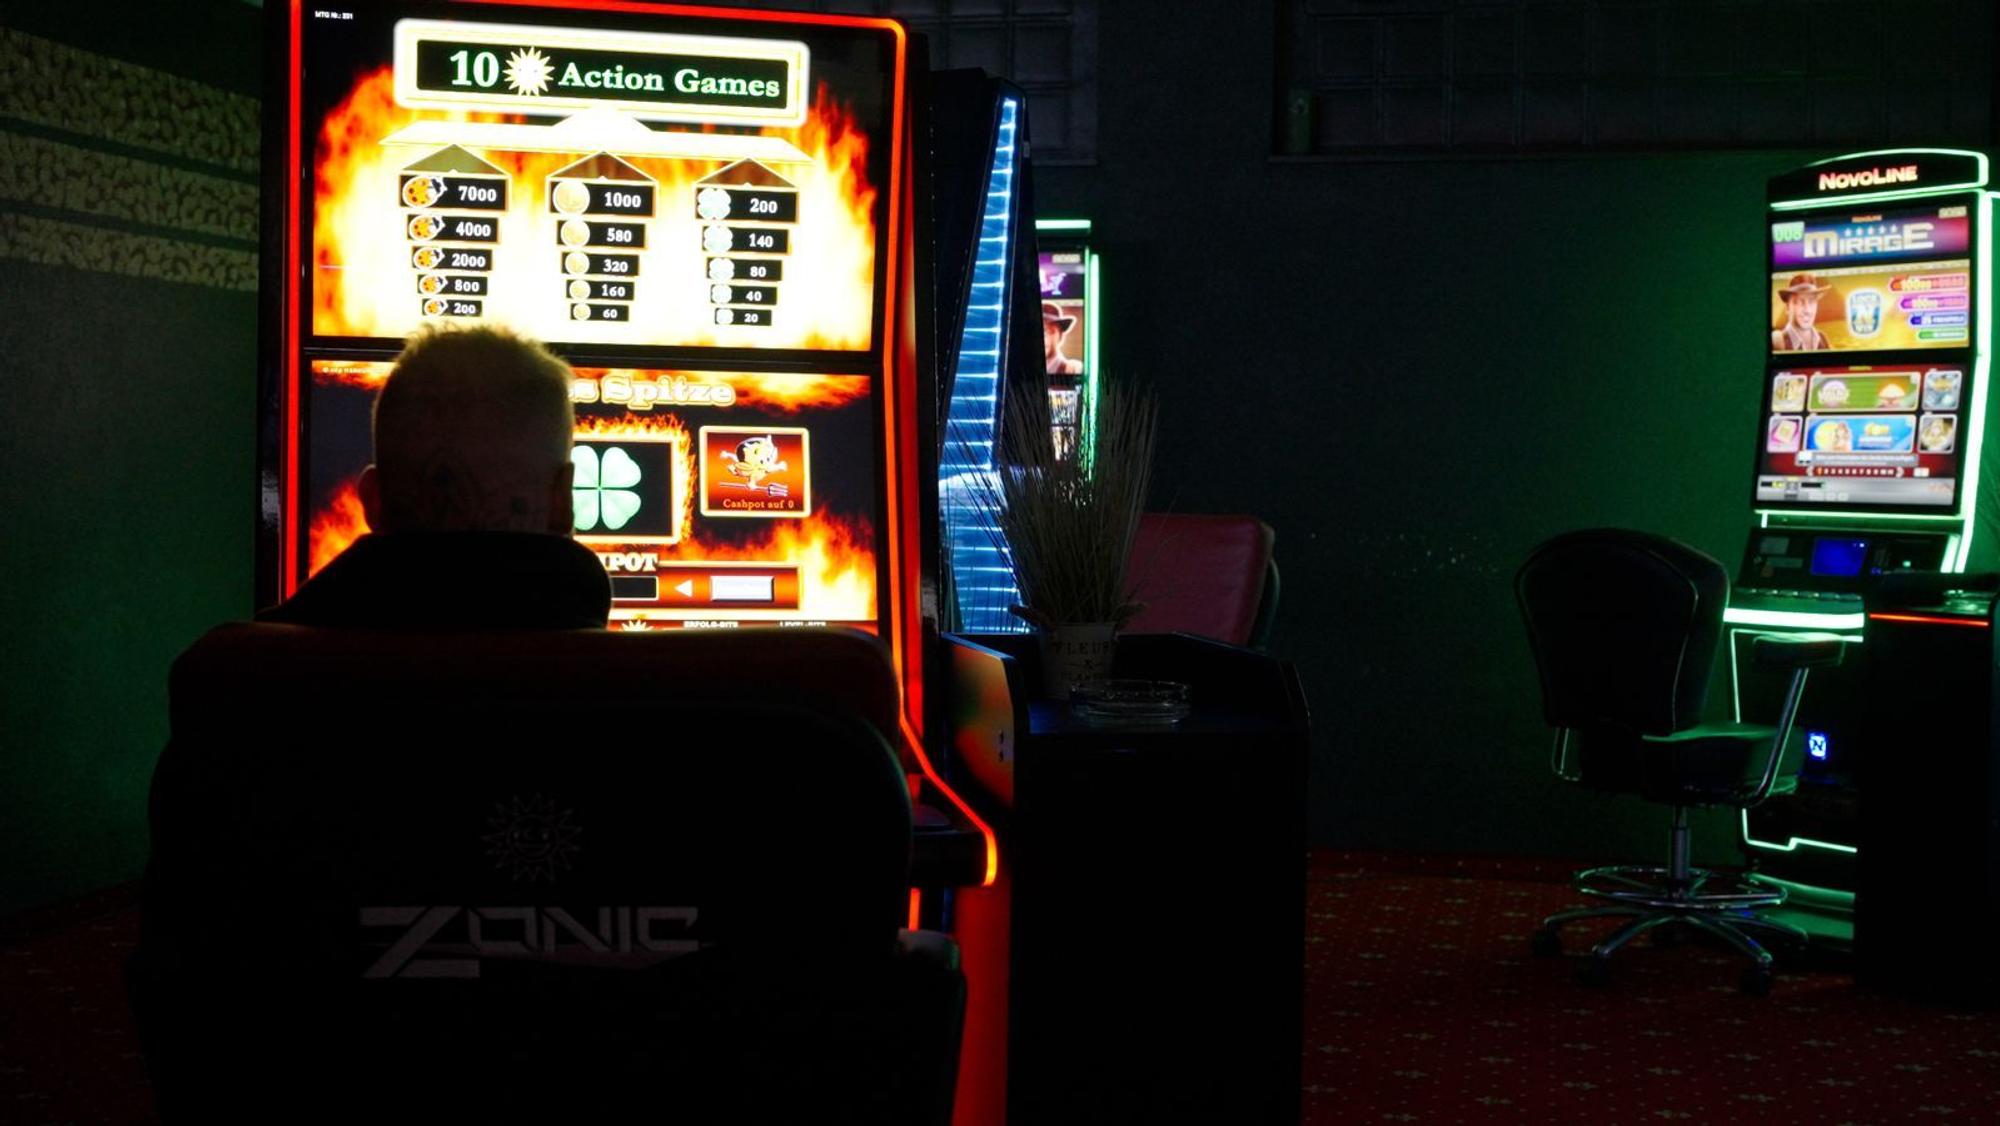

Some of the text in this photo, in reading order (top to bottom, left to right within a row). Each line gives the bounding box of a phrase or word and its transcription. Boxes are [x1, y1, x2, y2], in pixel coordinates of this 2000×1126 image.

[450, 50, 780, 98] 10 Action Games
[1819, 165, 1918, 190] NOVOLINE
[458, 186, 497, 202] 7000
[604, 191, 642, 208] 1000
[749, 198, 778, 214] 200
[456, 222, 492, 237] 4000
[606, 227, 632, 243] 580
[749, 233, 774, 248] 140
[1804, 222, 1934, 258] MIRAGE
[451, 253, 486, 268] 2000
[603, 259, 629, 273] 320
[750, 266, 767, 278] 80
[454, 279, 480, 293] 800
[601, 284, 626, 297] 160
[745, 291, 762, 302] 40
[453, 302, 477, 315] 200
[602, 308, 618, 319] 60
[744, 313, 759, 323] 20
[601, 375, 736, 410] Spitze
[723, 499, 765, 511] Cashpot
[767, 500, 785, 509] auf
[358, 903, 702, 980] ZONIC
